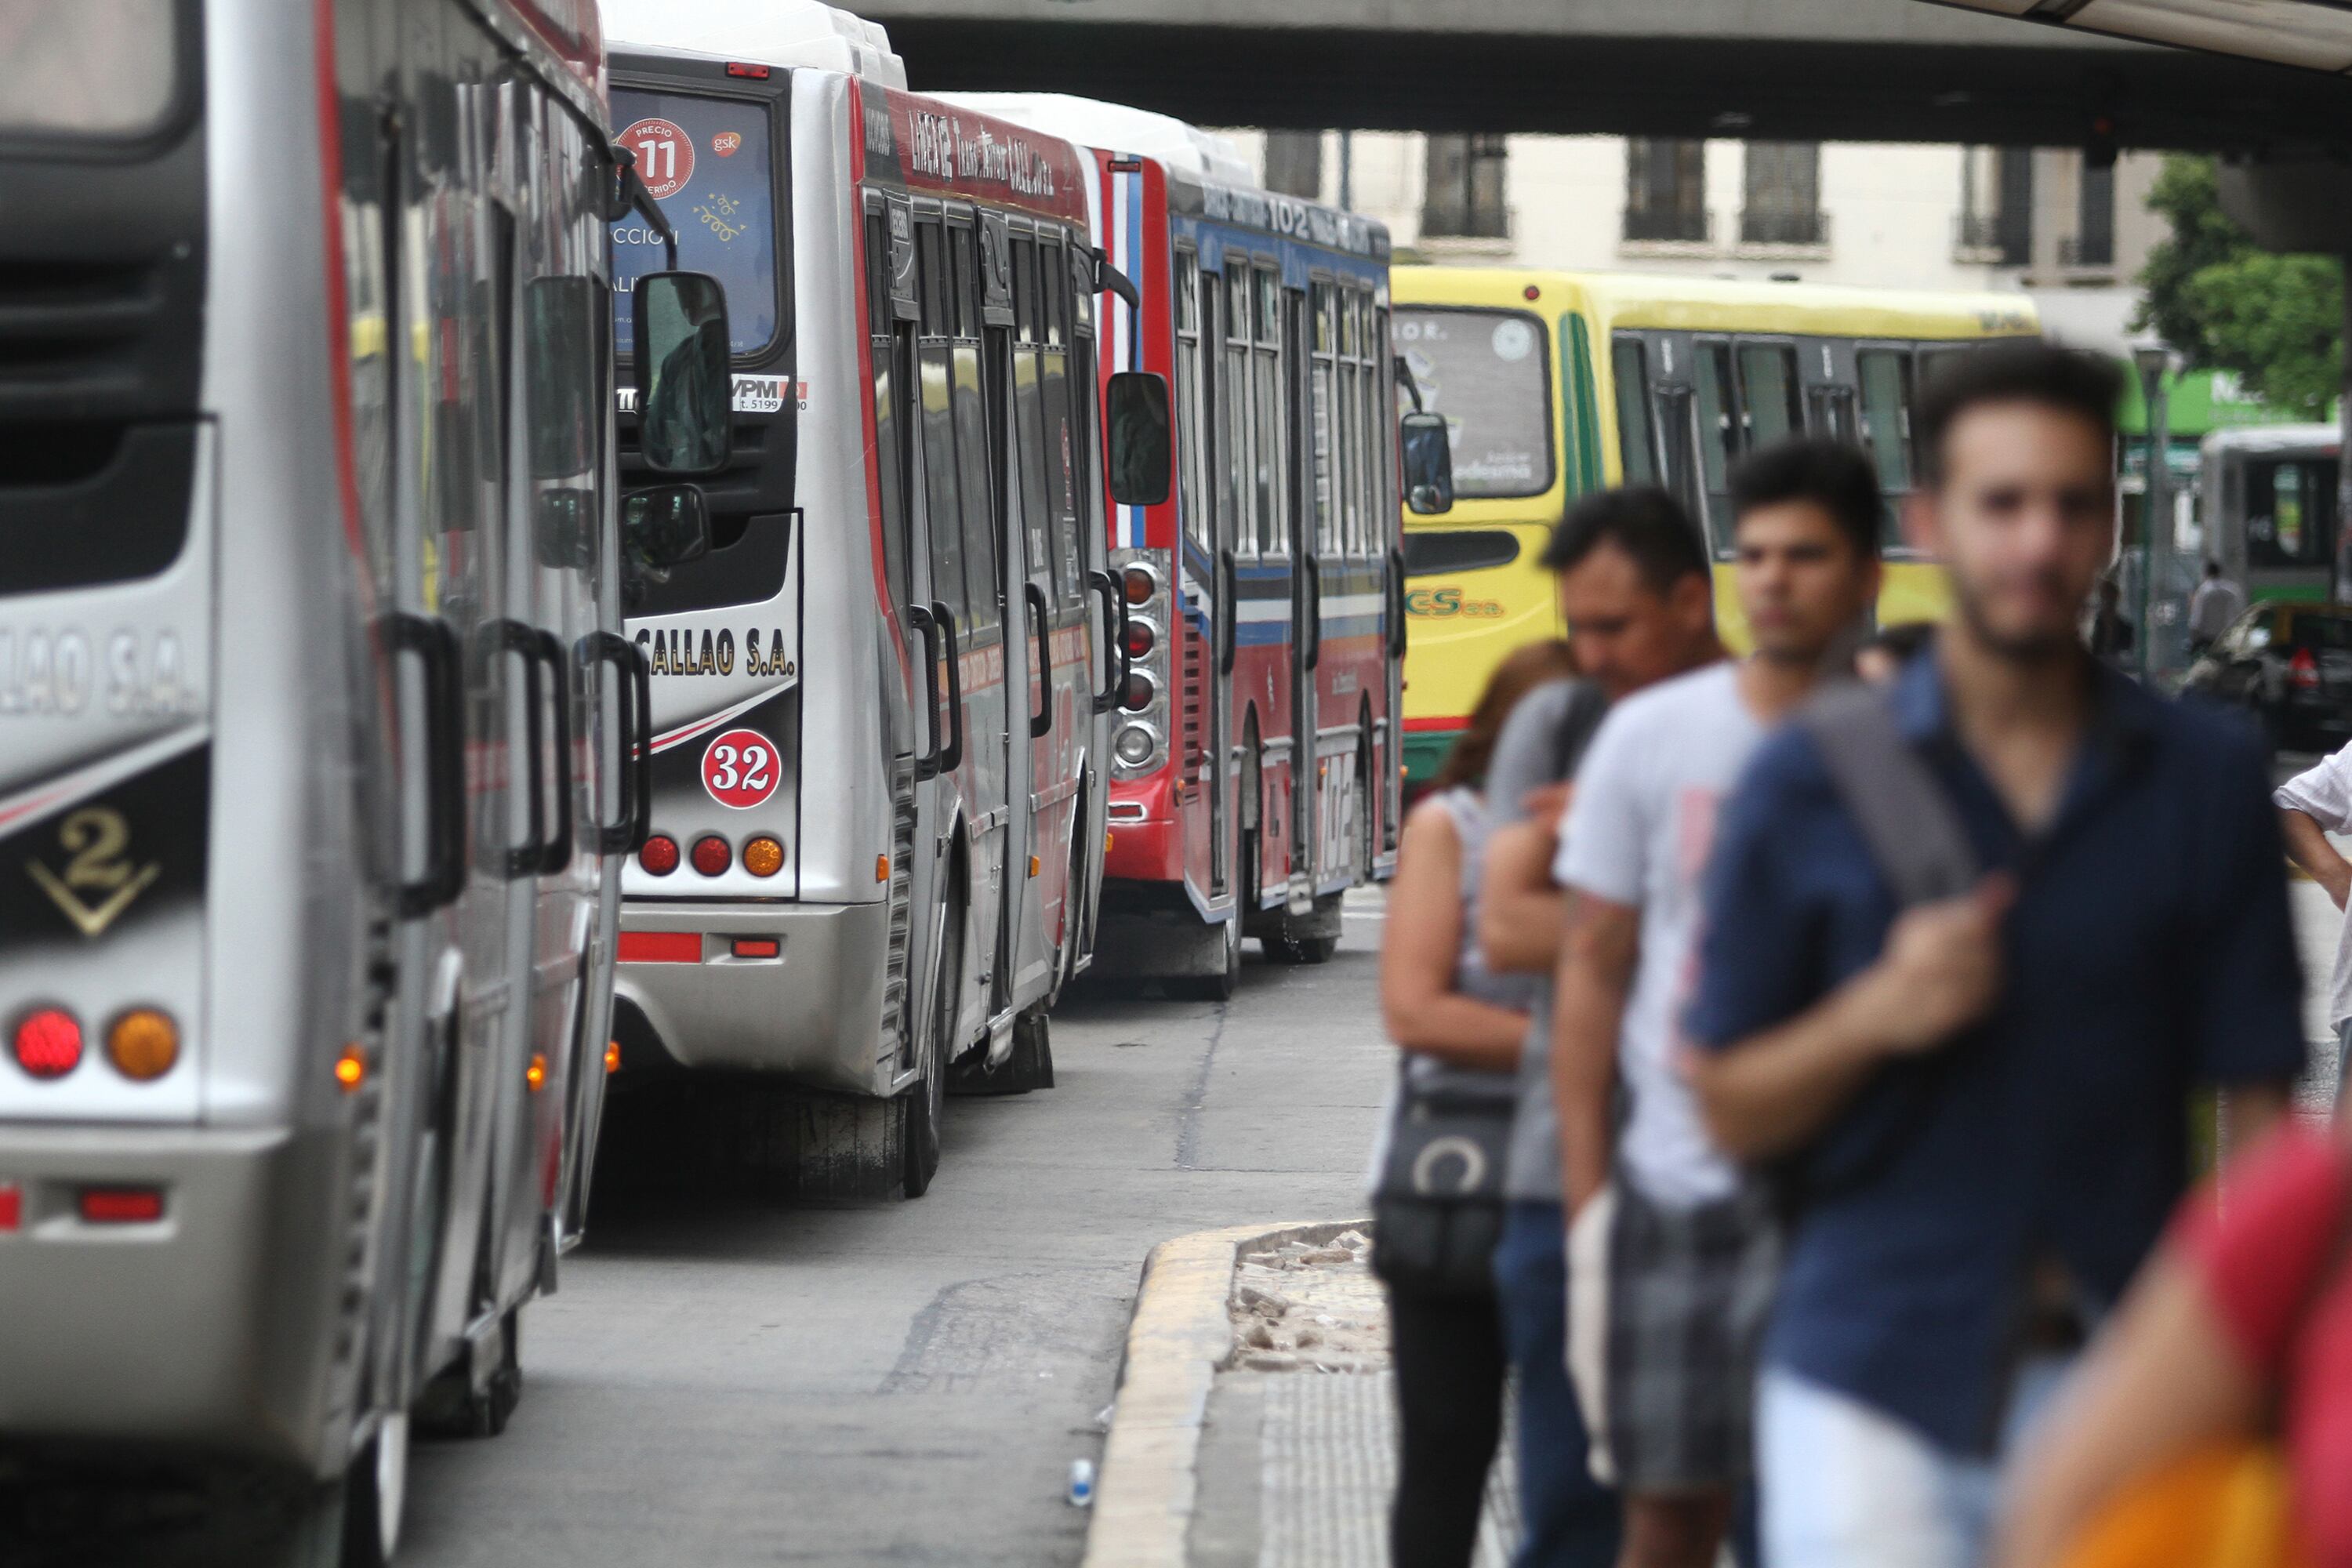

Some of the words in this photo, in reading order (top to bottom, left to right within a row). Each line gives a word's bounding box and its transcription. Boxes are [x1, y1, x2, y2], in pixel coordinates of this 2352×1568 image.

[636, 125, 672, 137] PRECIO
[714, 136, 736, 151] gsk
[638, 140, 675, 178] 11
[645, 180, 677, 194] ERIDO
[1267, 198, 1312, 240] 102
[750, 400, 779, 410] 5199
[746, 628, 795, 677] S.A.
[712, 745, 769, 790] 32
[59, 805, 135, 888] 2
